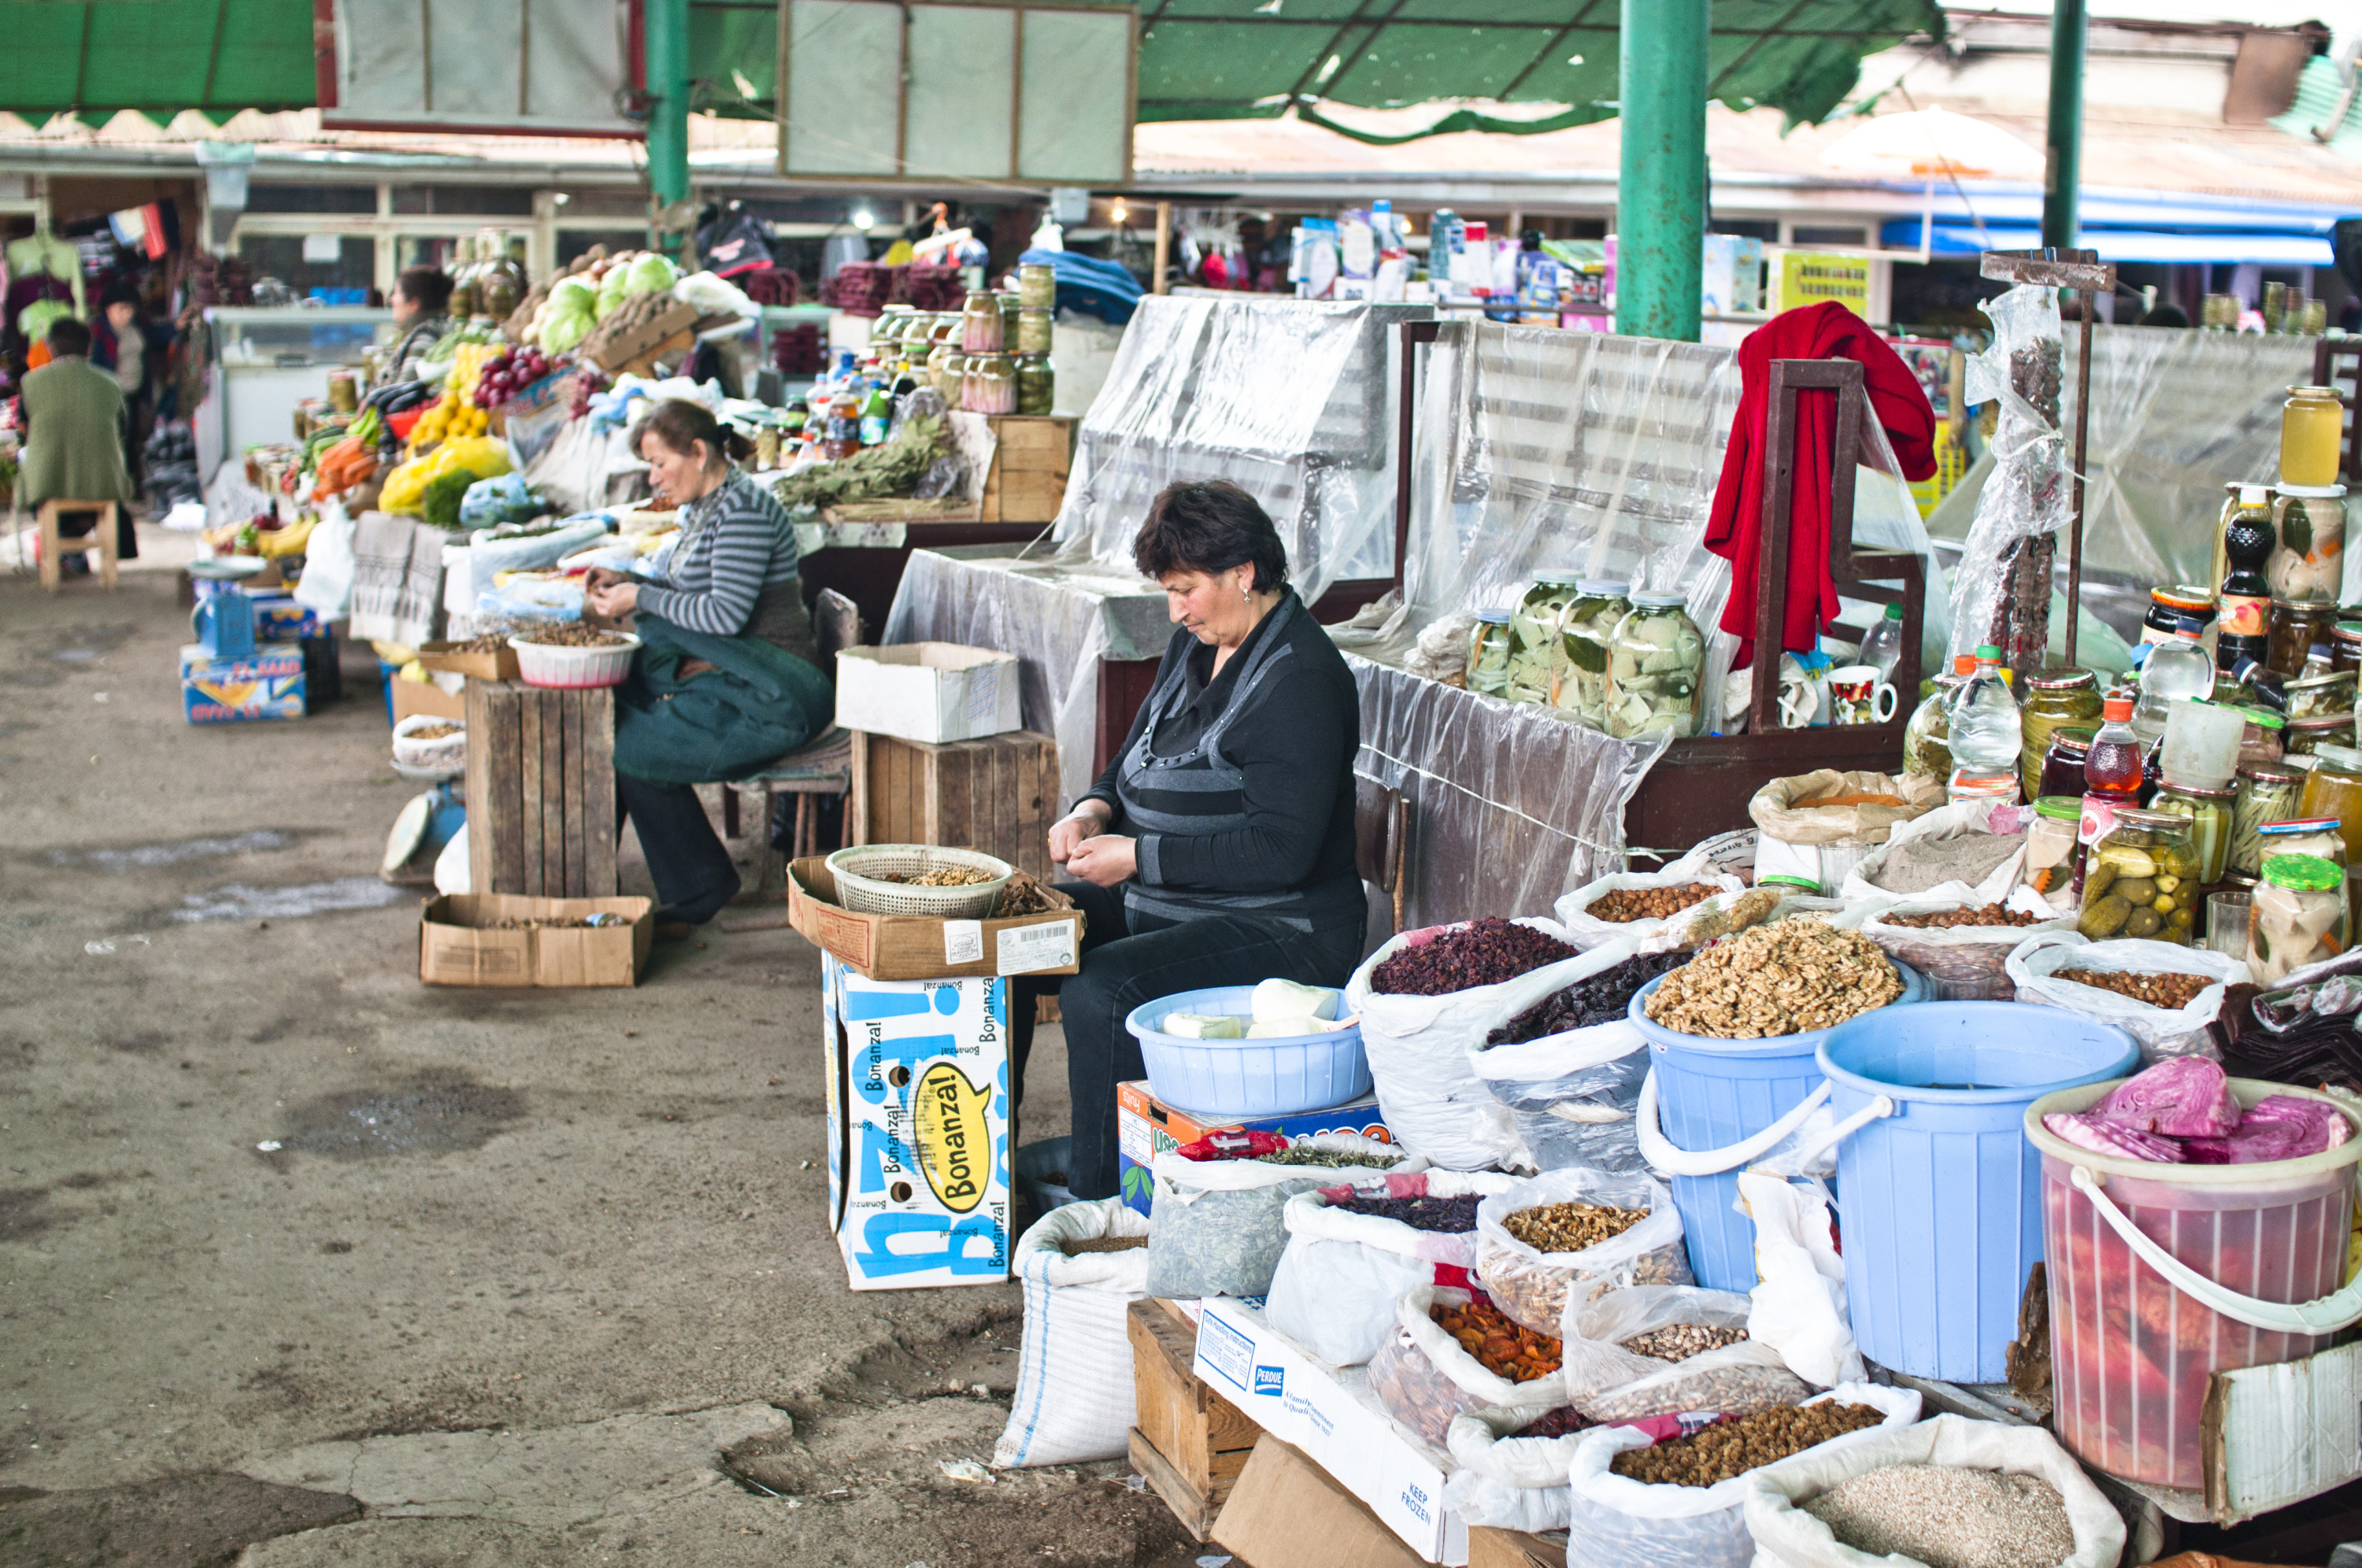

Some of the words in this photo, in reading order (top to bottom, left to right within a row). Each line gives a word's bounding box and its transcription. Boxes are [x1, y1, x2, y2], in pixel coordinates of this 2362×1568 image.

[924, 981, 963, 991] Bonanza!
[979, 977, 997, 1042] Bonanza
[864, 1022, 884, 1091] Bonanza!
[941, 1045, 980, 1056] Bonanza!
[883, 1105, 901, 1173] Bonanza!
[927, 1074, 978, 1200] Bonanza!
[851, 1200, 887, 1210] Bonanza
[939, 1228, 979, 1237] Bonanza!
[989, 1201, 1005, 1267] Bonanza!
[1256, 1368, 1283, 1384] PERDUE
[1409, 1481, 1427, 1504] KEEP
[1401, 1491, 1431, 1526] FROZEN
